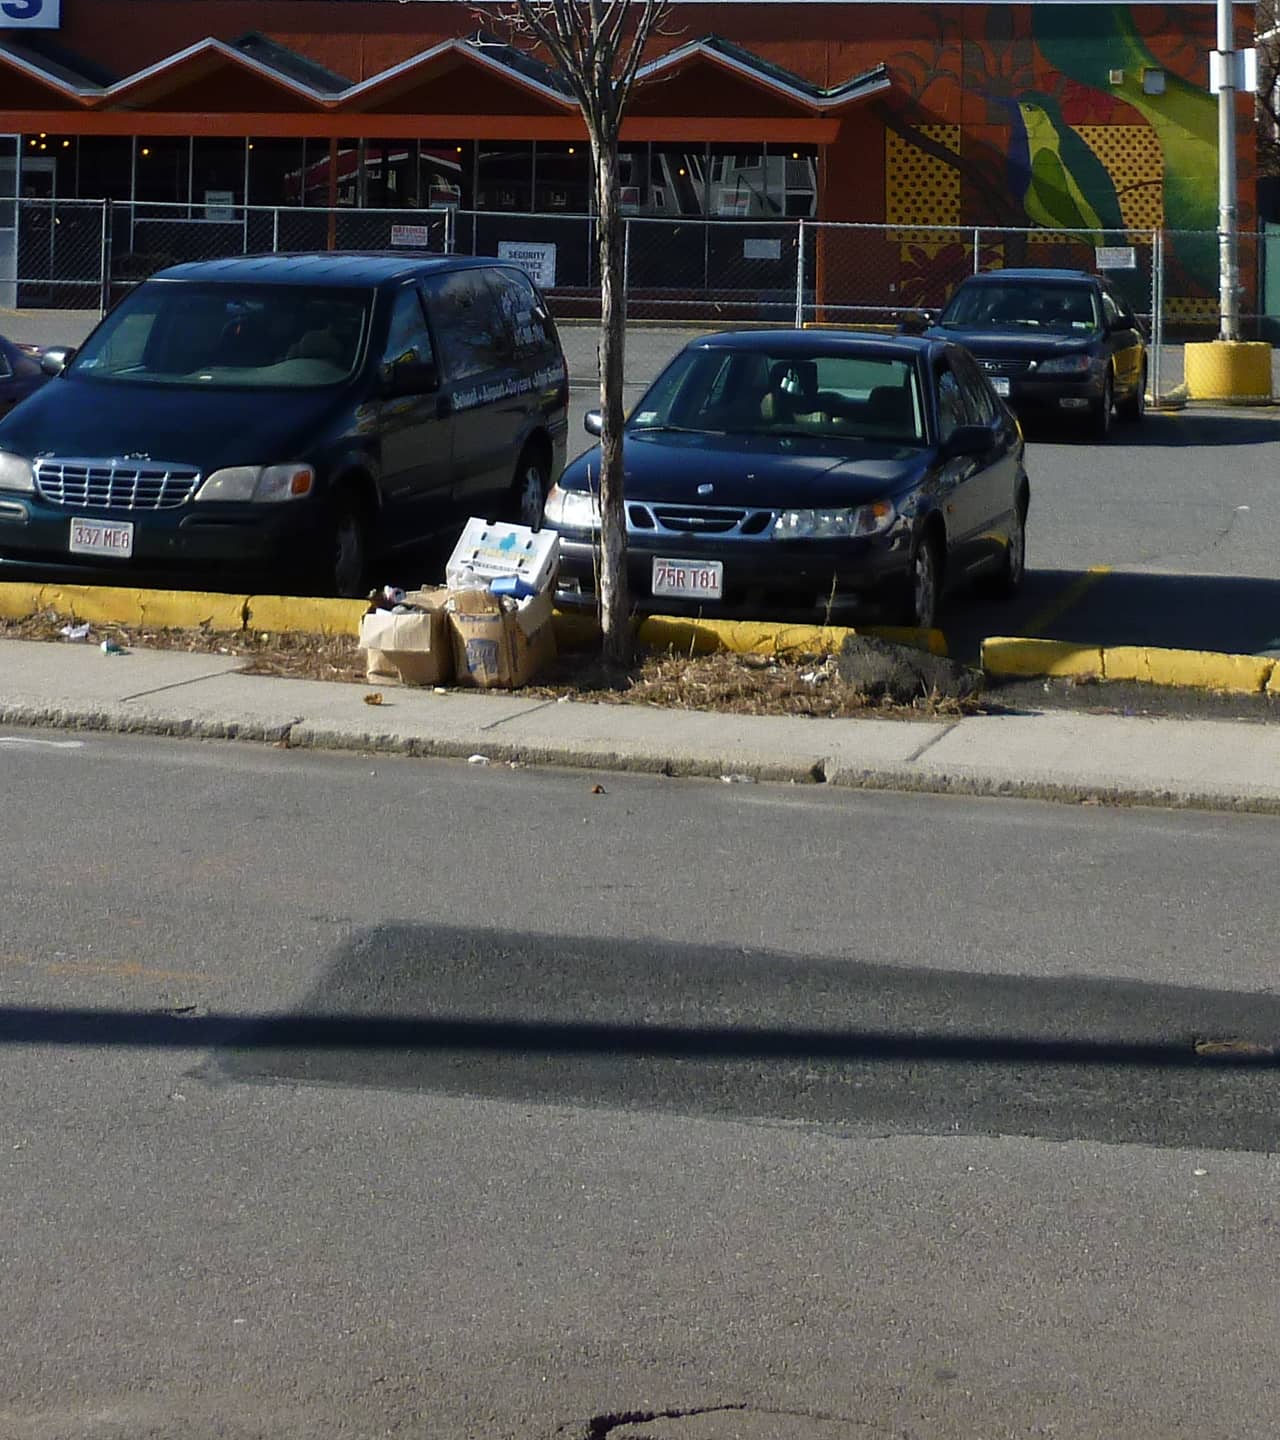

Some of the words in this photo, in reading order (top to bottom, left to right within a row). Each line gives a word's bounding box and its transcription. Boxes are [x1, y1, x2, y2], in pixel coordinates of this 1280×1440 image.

[508, 250, 546, 259] SECURITY
[75, 527, 100, 545] 337
[657, 568, 686, 588] 75R
[690, 570, 719, 590] T81
